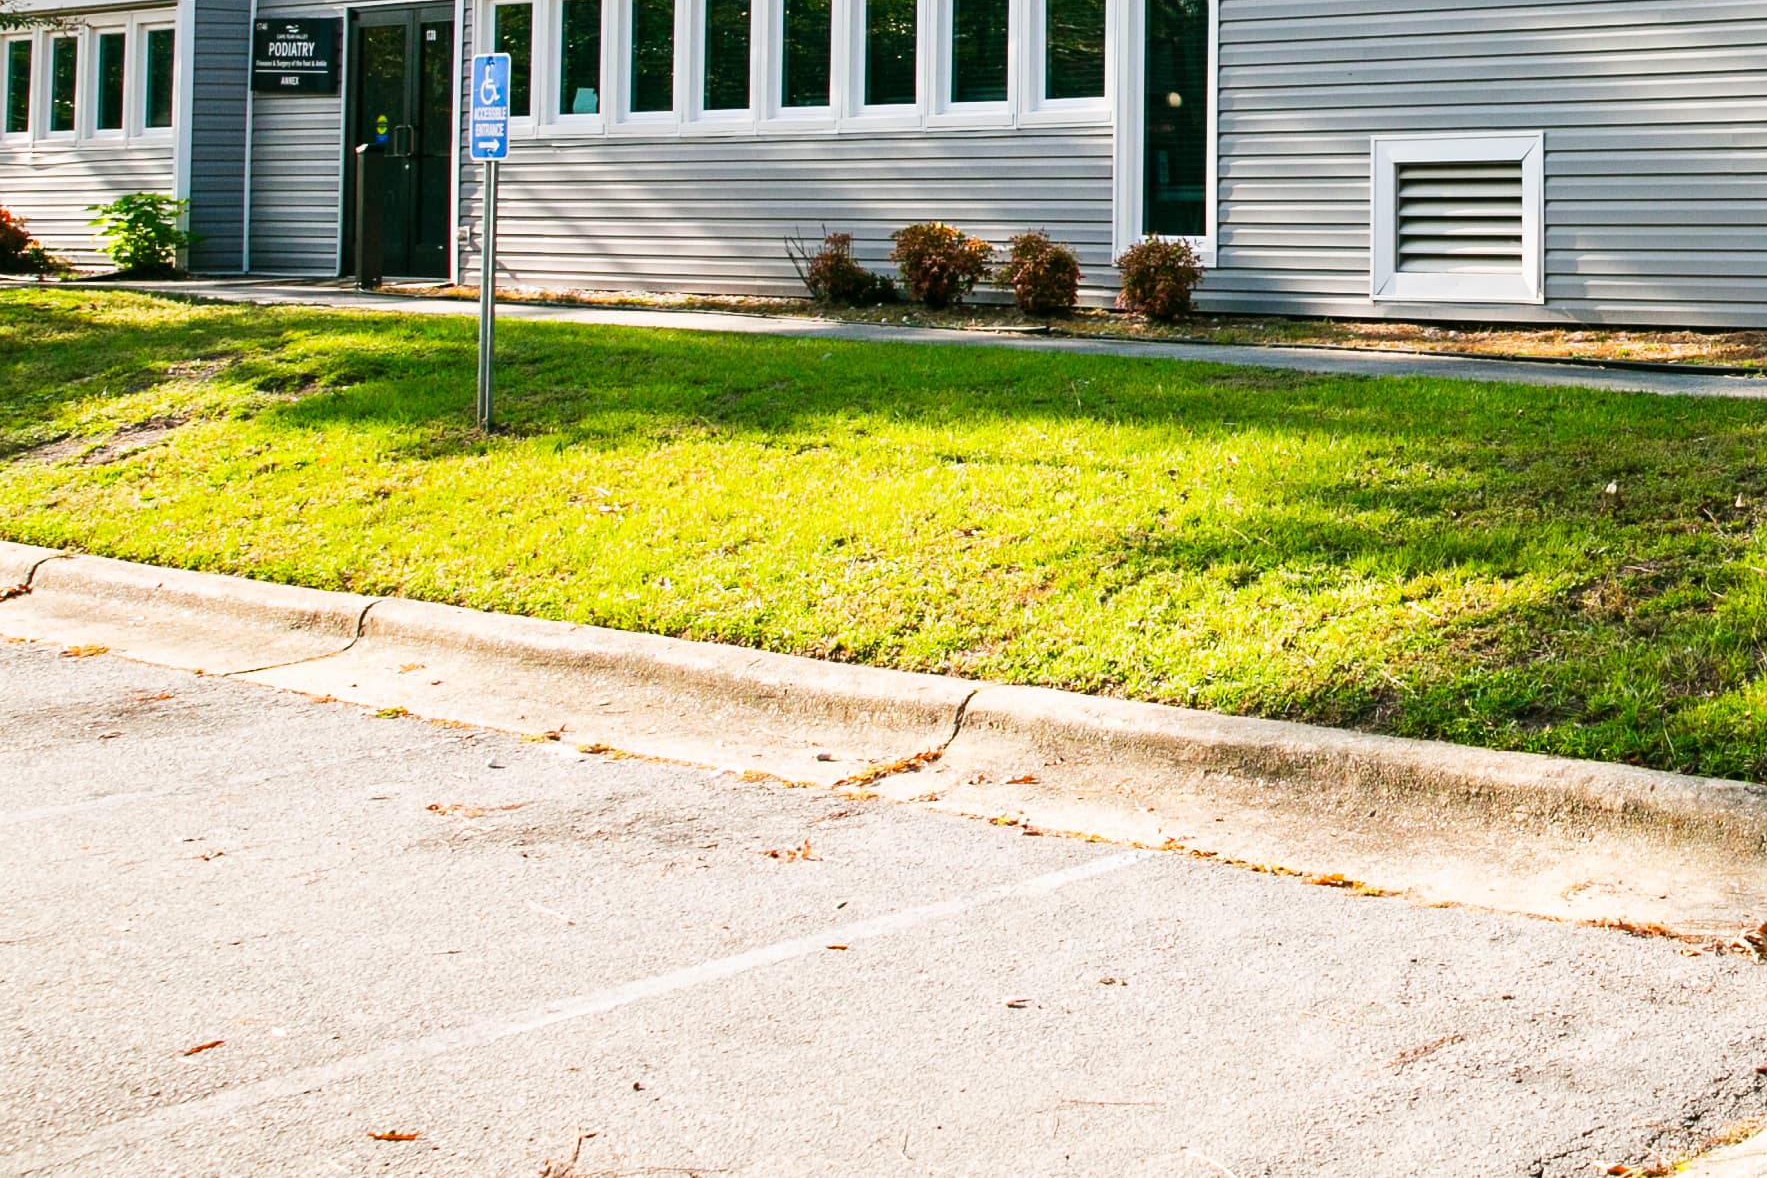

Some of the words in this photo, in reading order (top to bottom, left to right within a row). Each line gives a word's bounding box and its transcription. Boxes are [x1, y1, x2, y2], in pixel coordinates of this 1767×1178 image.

[268, 42, 315, 56] PODIATRY
[280, 76, 300, 85] ANNEX
[474, 107, 507, 120] ACCESSIBLE
[475, 123, 505, 136] ENTRANCE
